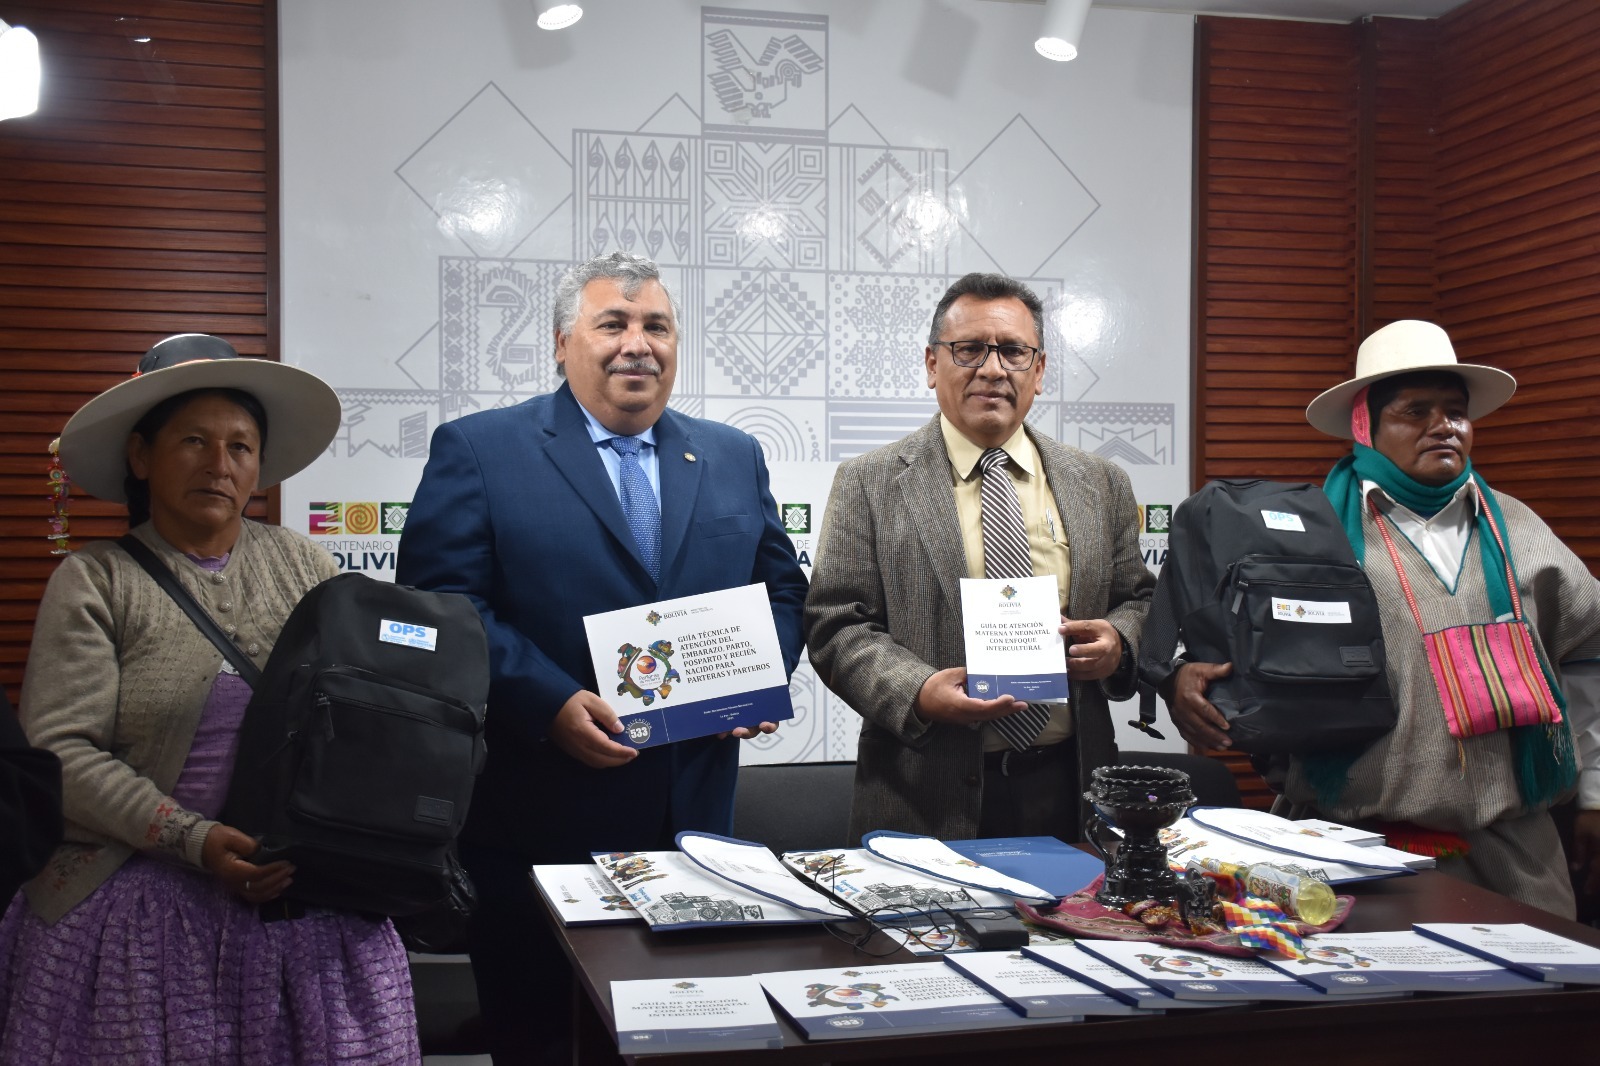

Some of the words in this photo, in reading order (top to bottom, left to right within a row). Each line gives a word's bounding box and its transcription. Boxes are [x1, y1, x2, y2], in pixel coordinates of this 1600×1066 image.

[796, 540, 810, 550] DE
[389, 623, 426, 638] OPS
[678, 632, 697, 643] GUÍA
[698, 626, 730, 639] TÉCNICA
[730, 626, 742, 634] DE
[680, 638, 718, 651] ATENCIÓN
[718, 635, 734, 644] DEL
[683, 655, 722, 668] POSPARTO
[723, 654, 730, 662] Y
[730, 648, 757, 660] RECIÉN
[685, 664, 714, 676] NACIDO
[715, 661, 736, 670] PARA
[687, 672, 726, 684] PARTERAS
[726, 670, 732, 678] Y
[733, 663, 770, 677] PARTEROS
[630, 726, 648, 738] 533
